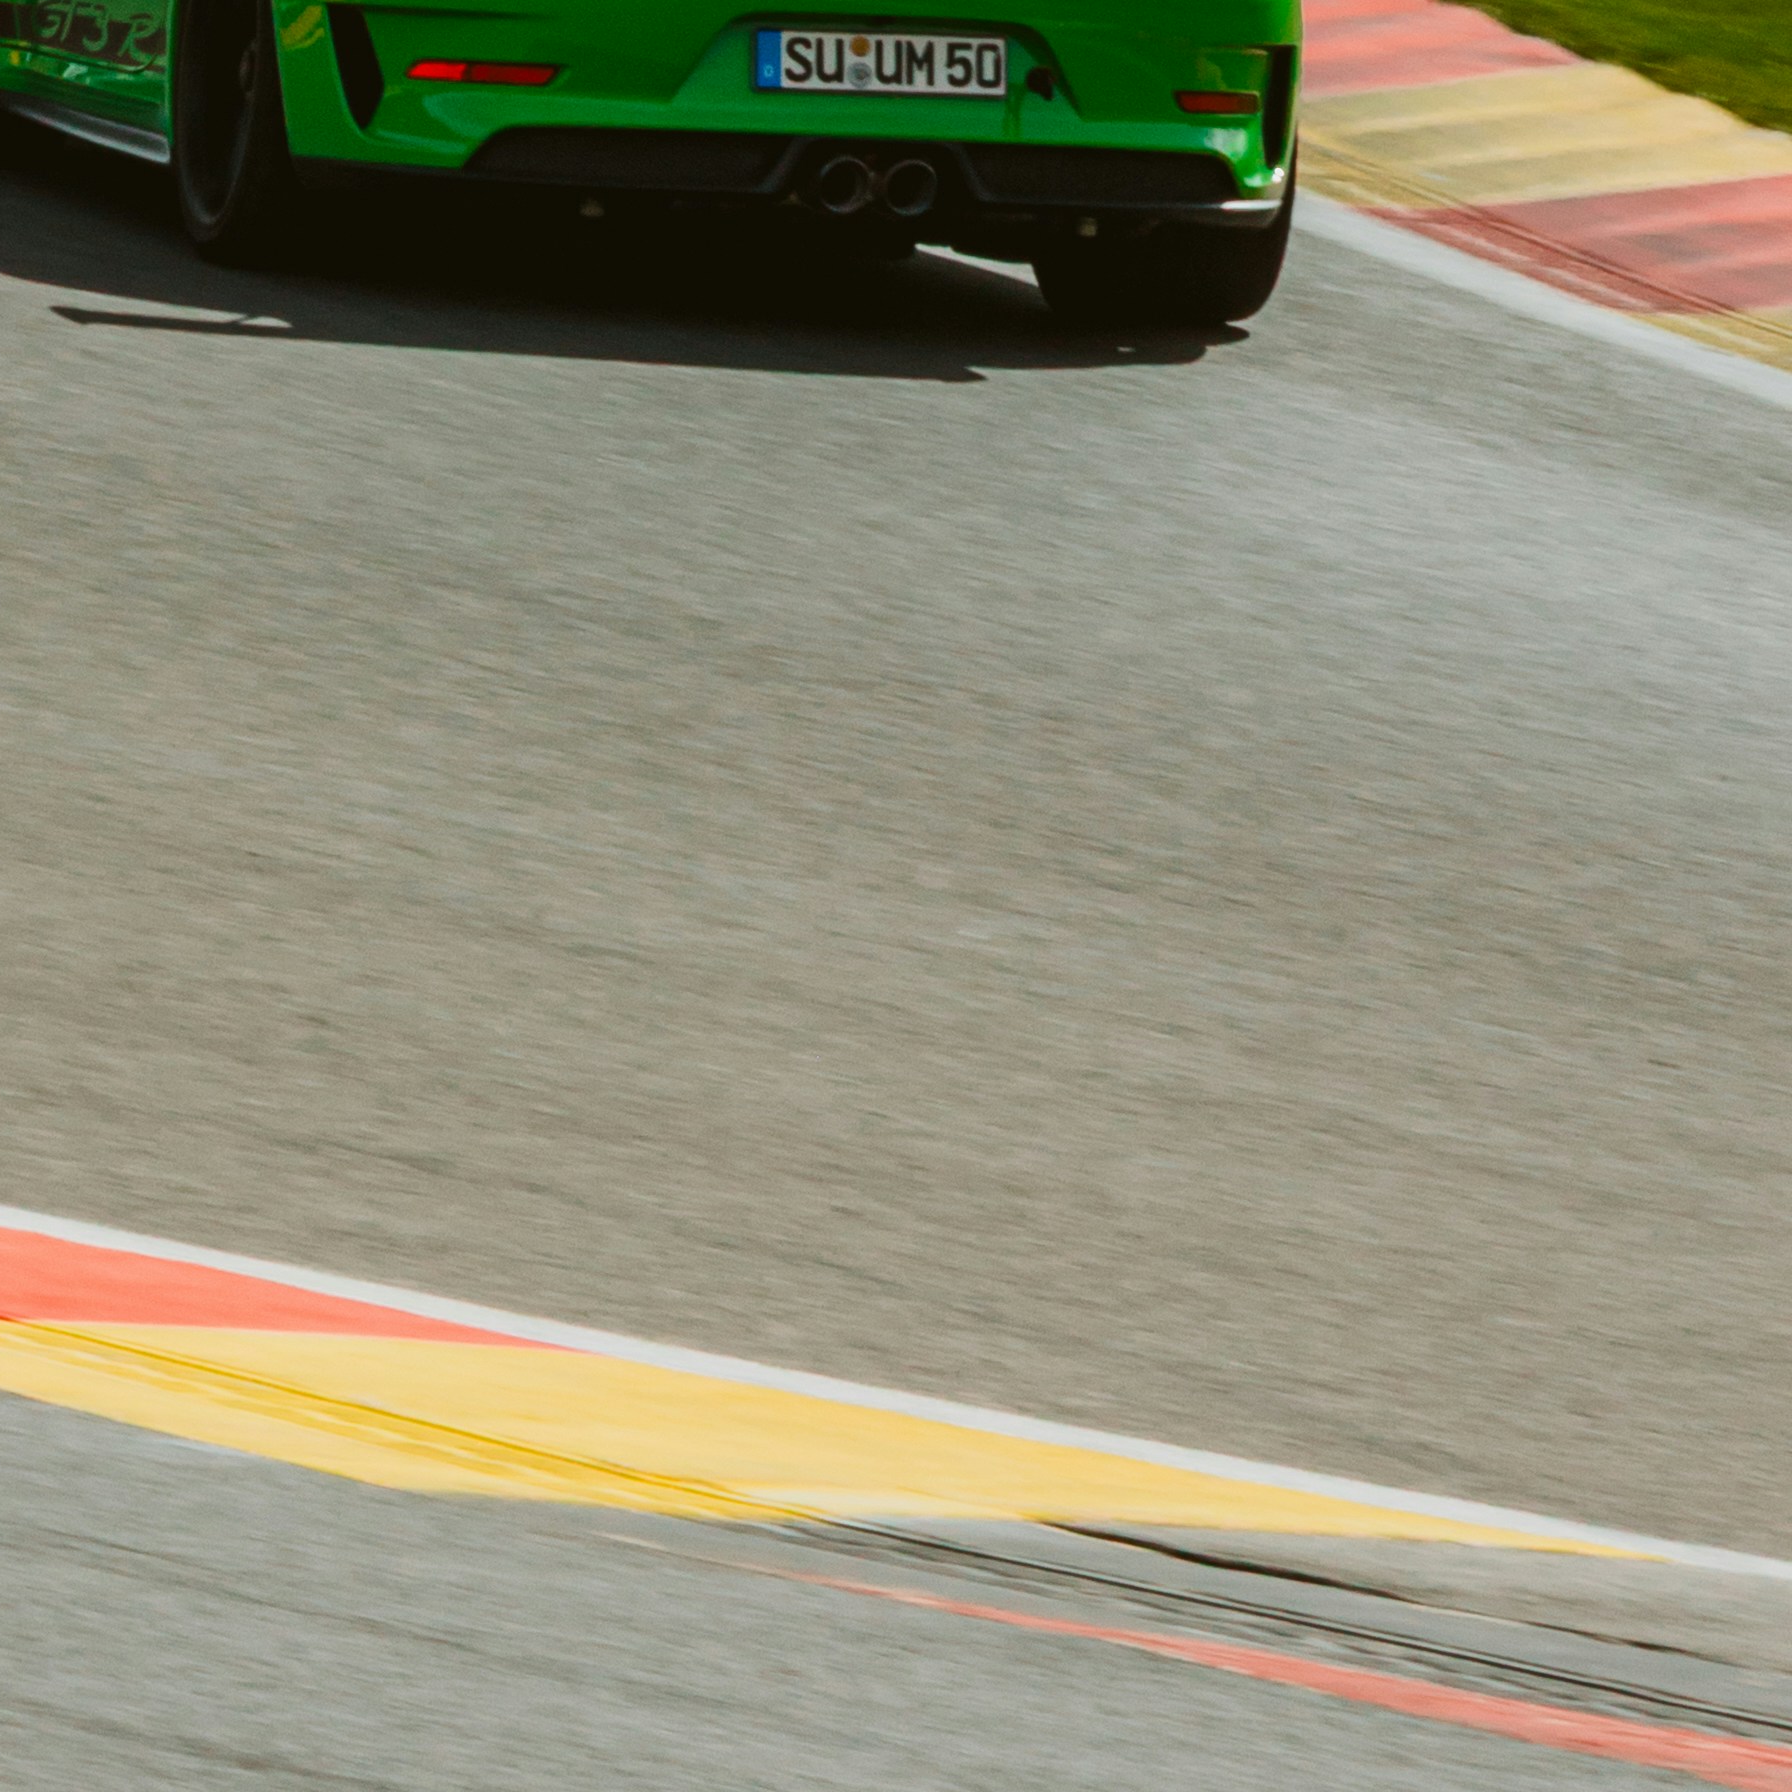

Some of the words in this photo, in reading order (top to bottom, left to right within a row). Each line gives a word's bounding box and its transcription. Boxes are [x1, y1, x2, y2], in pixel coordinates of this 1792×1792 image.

[117, 13, 165, 68] R
[784, 36, 845, 84] SU
[874, 39, 935, 86] UM
[946, 42, 1002, 89] 50
